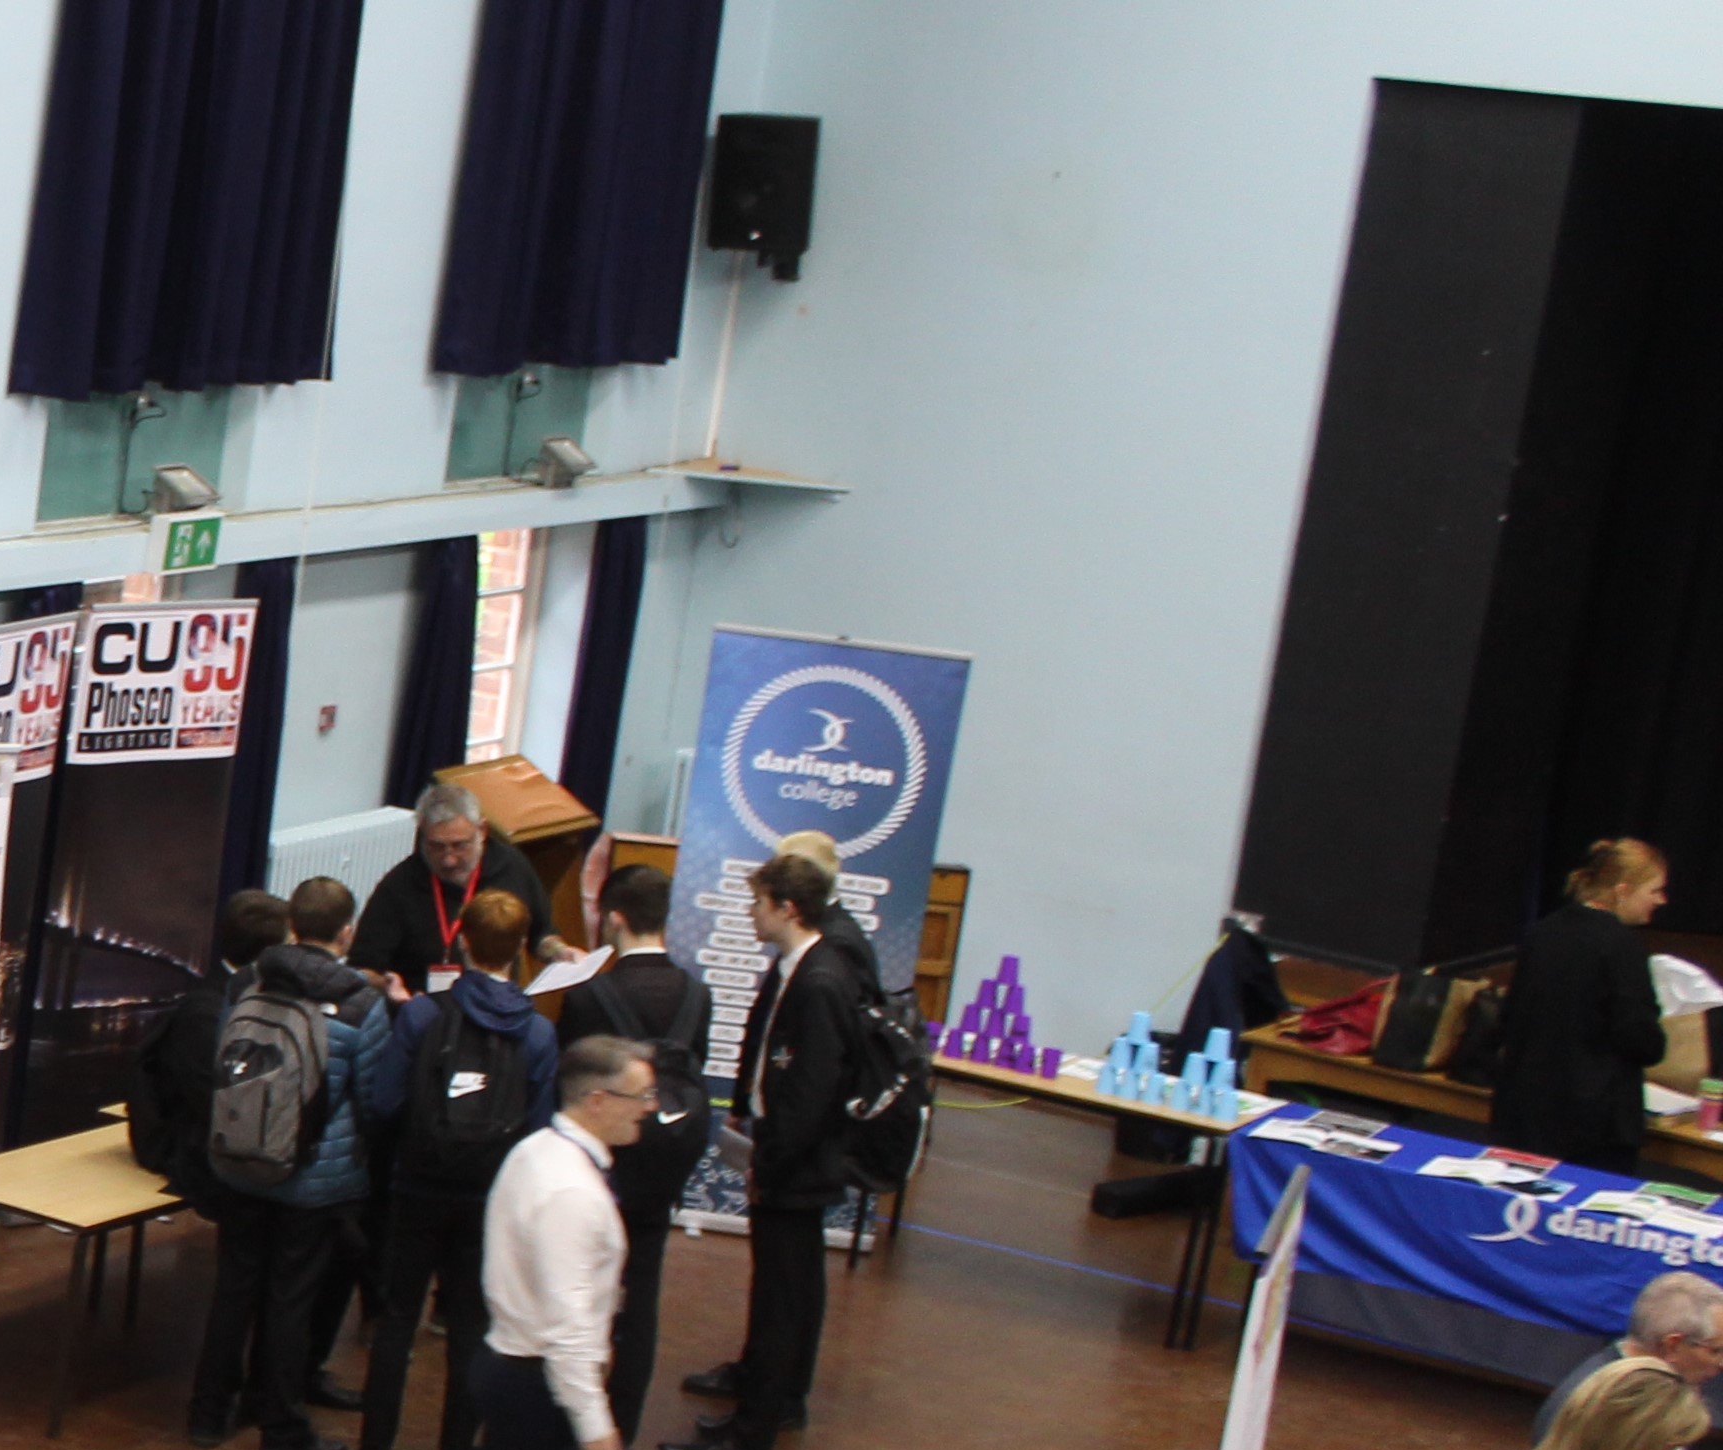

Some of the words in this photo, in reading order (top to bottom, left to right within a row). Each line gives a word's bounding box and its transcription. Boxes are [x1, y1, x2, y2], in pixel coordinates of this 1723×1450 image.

[92, 621, 182, 676] CU
[183, 613, 248, 692] 95
[85, 682, 174, 728] Phosco
[80, 733, 171, 750] LIGHTING
[752, 749, 894, 786] darlington
[778, 780, 859, 811] college
